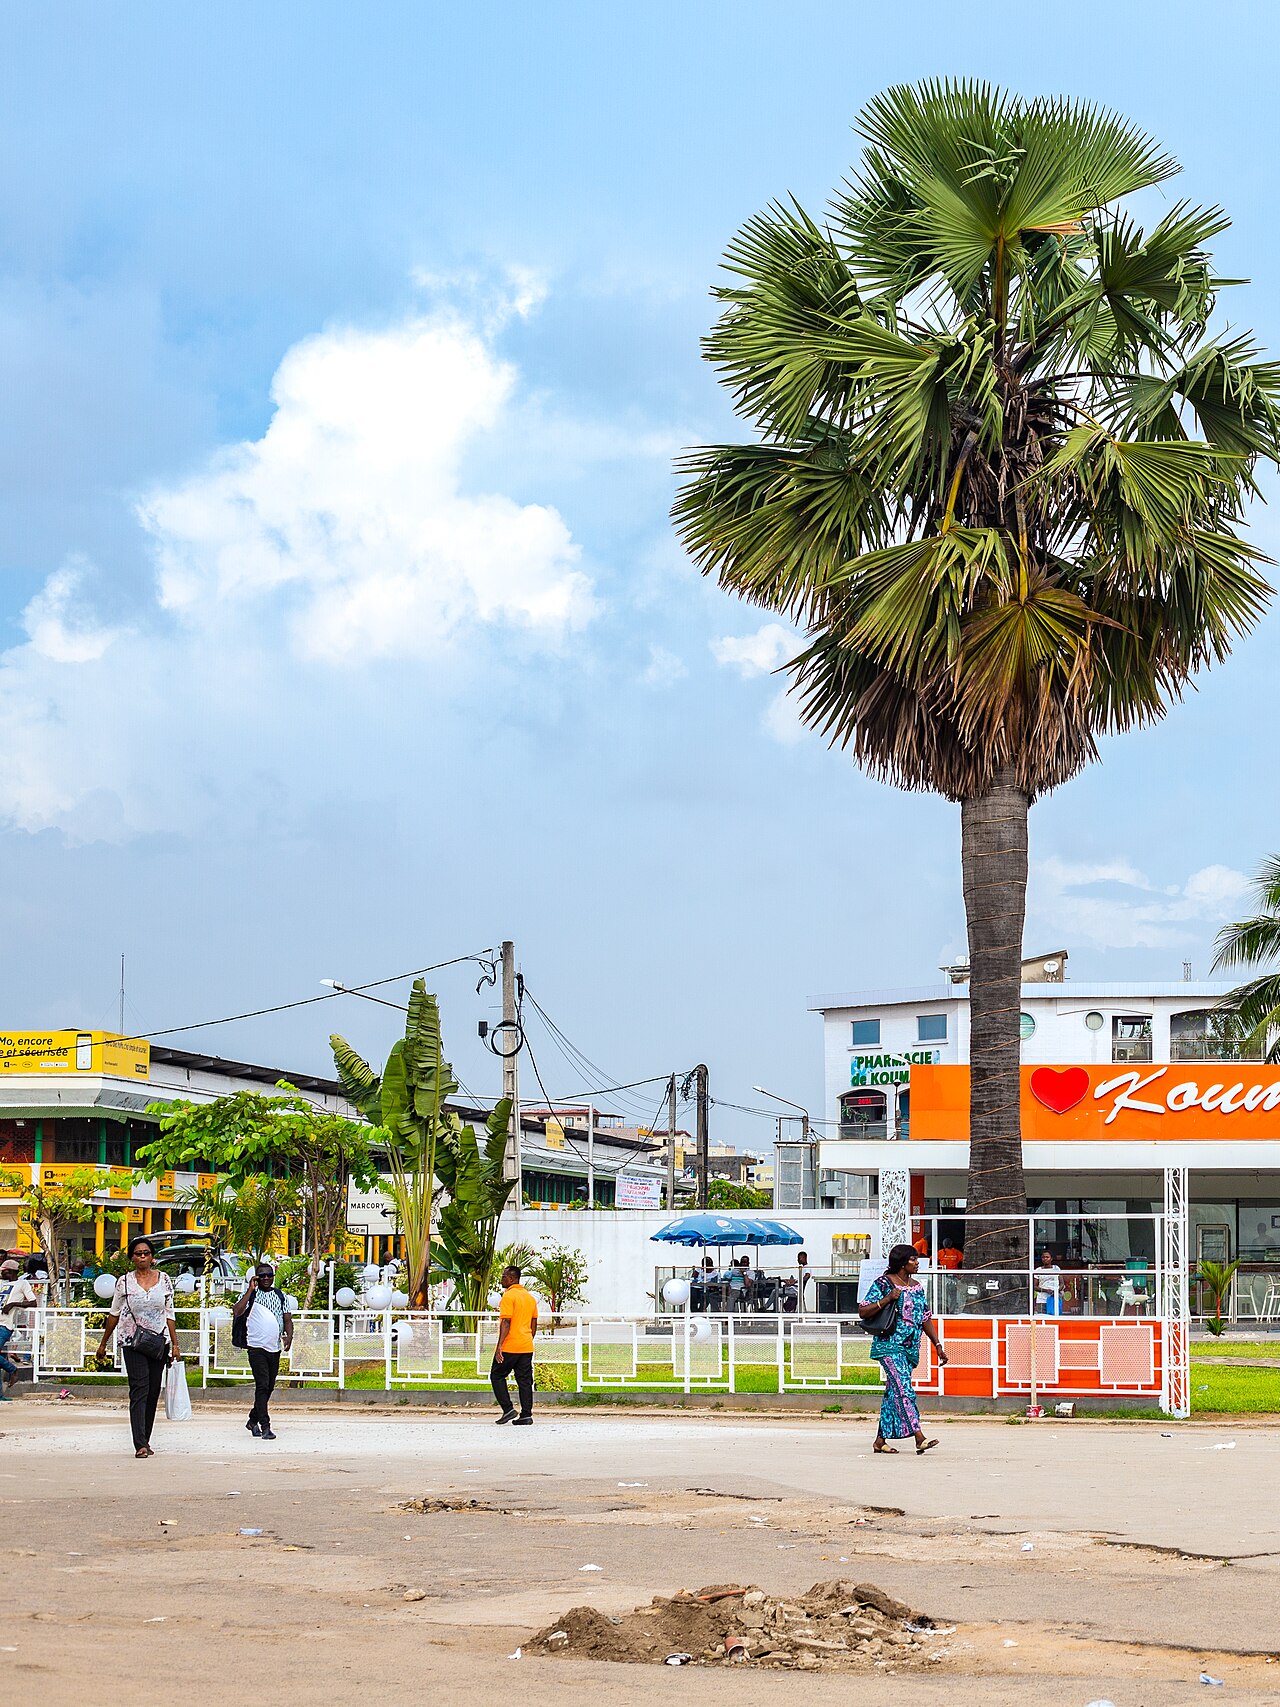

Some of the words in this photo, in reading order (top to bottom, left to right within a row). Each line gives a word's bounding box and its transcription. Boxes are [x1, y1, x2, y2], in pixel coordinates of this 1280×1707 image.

[17, 1037, 53, 1046] encore
[6, 1047, 17, 1057] et
[19, 1046, 69, 1057] sécurisée
[851, 1072, 867, 1086] de
[870, 1070, 910, 1085] KOUM
[350, 1202, 385, 1210] MARCORY
